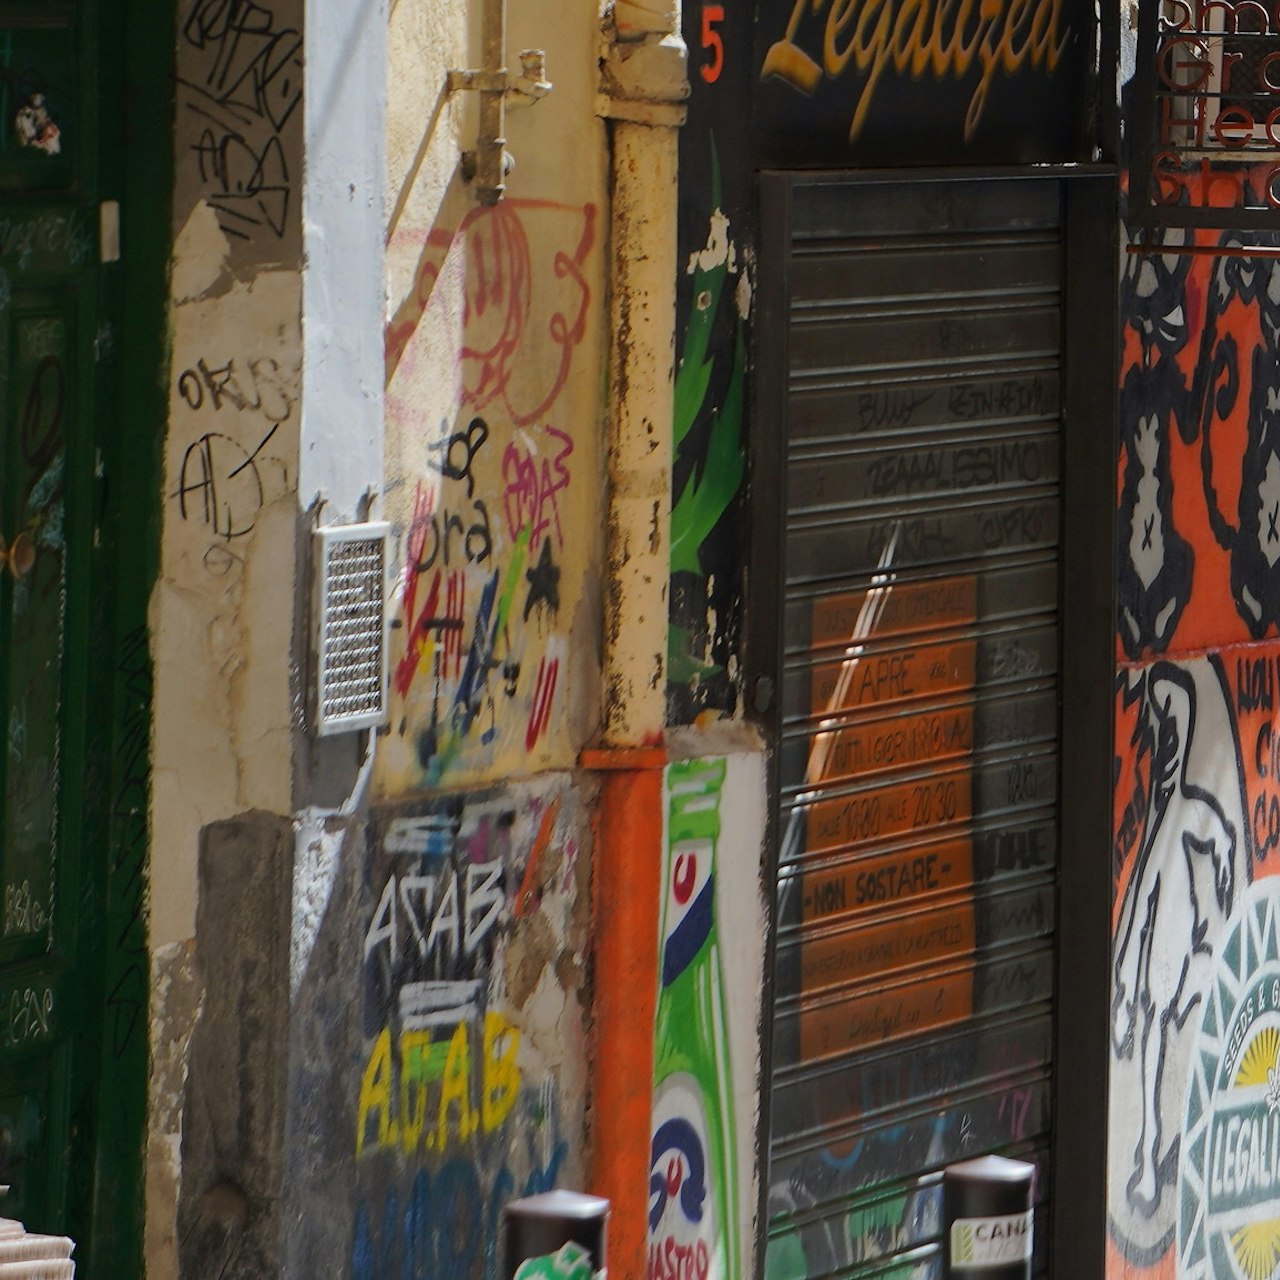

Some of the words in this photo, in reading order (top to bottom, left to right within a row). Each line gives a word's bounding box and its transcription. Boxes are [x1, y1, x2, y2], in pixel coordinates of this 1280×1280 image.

[700, 5, 725, 84] 5
[857, 653, 917, 704] APRE
[363, 856, 508, 964] ACAB
[1224, 1005, 1256, 1076] SEEDS
[1257, 984, 1268, 1010] &
